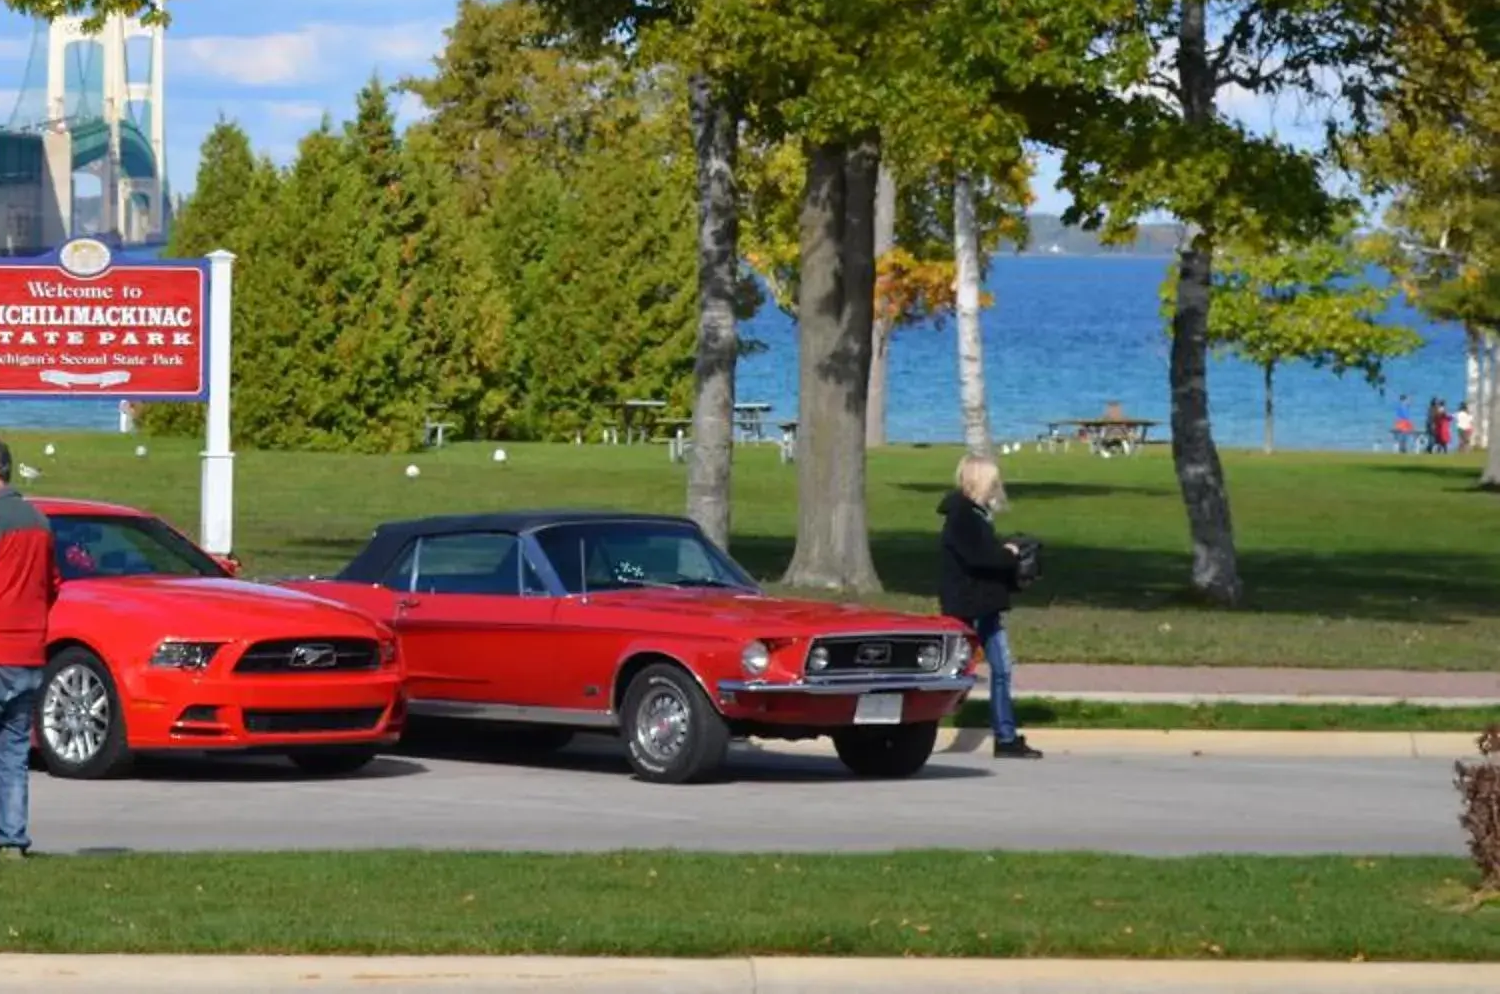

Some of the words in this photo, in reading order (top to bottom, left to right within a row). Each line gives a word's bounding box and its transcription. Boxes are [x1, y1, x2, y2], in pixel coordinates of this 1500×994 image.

[27, 281, 114, 299] Welcome
[123, 286, 143, 299] to
[98, 332, 194, 345] PARK
[60, 353, 108, 365] Second
[112, 354, 147, 365] State
[152, 354, 184, 366] Park
